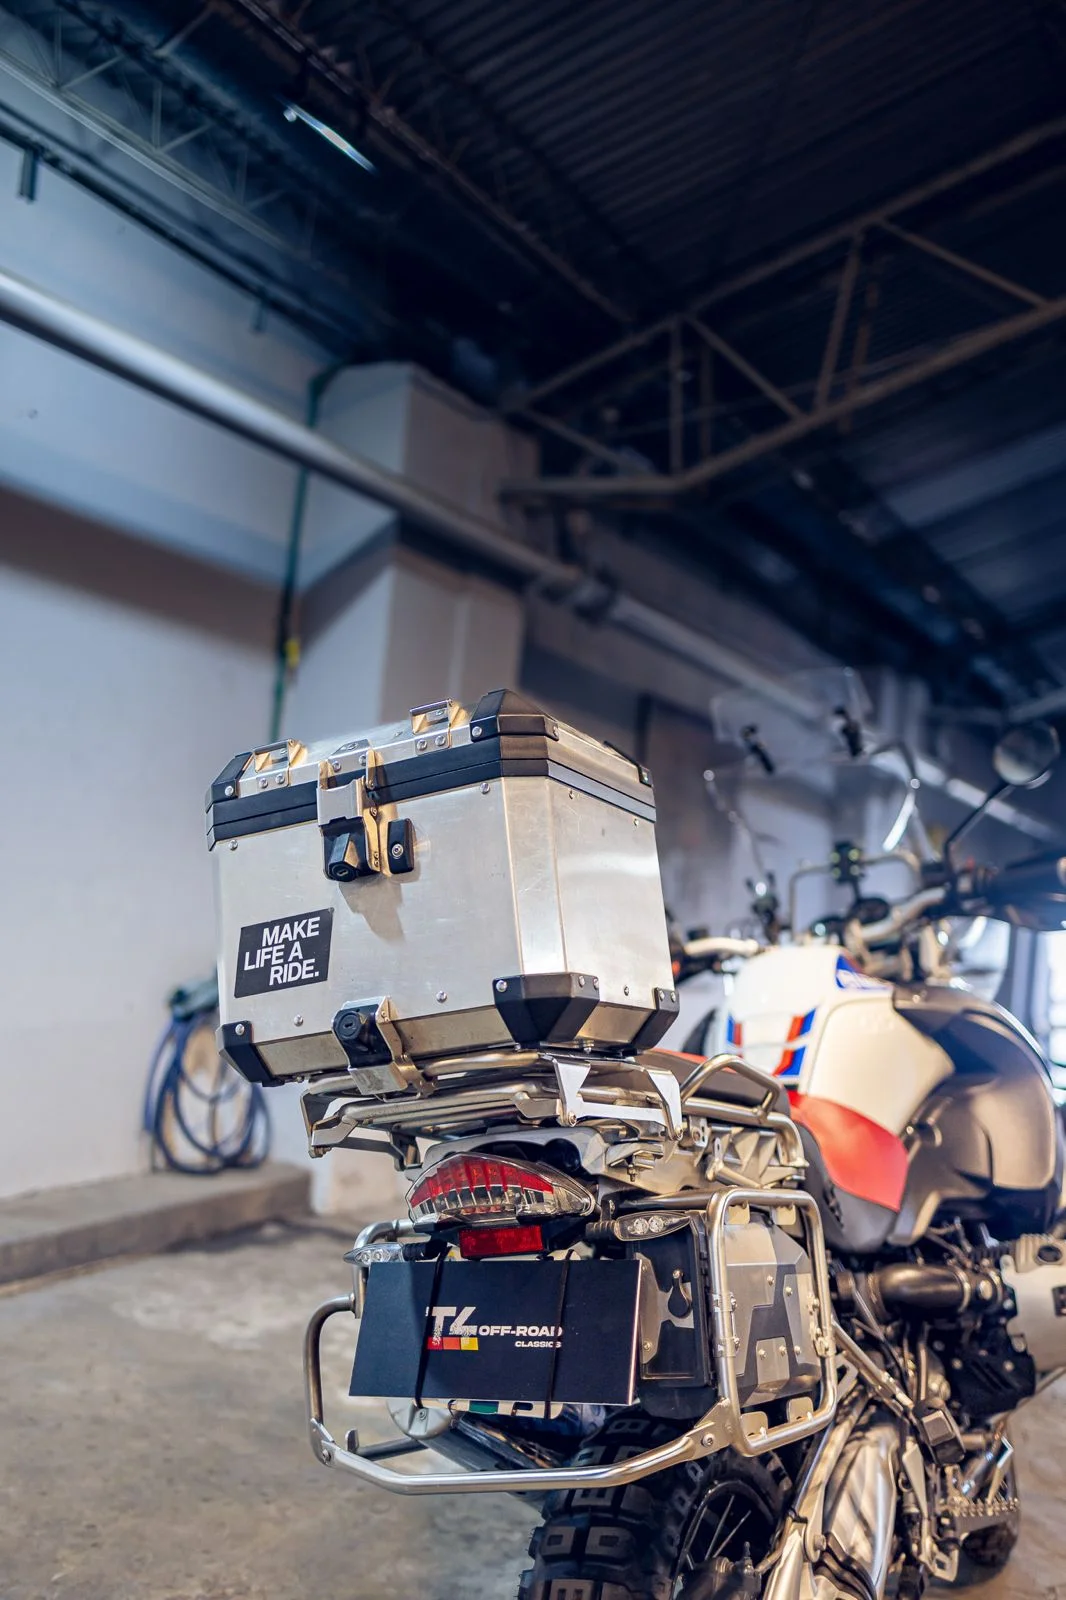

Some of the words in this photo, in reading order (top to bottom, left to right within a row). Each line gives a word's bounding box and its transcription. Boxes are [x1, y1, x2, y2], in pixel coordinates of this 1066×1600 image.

[262, 916, 321, 947] MAKE
[244, 944, 285, 971] LIFE
[288, 941, 304, 962] A
[269, 958, 320, 986] RIDE.
[478, 1325, 563, 1337] OFF-ROAD
[514, 1340, 562, 1348] CLASSICS
